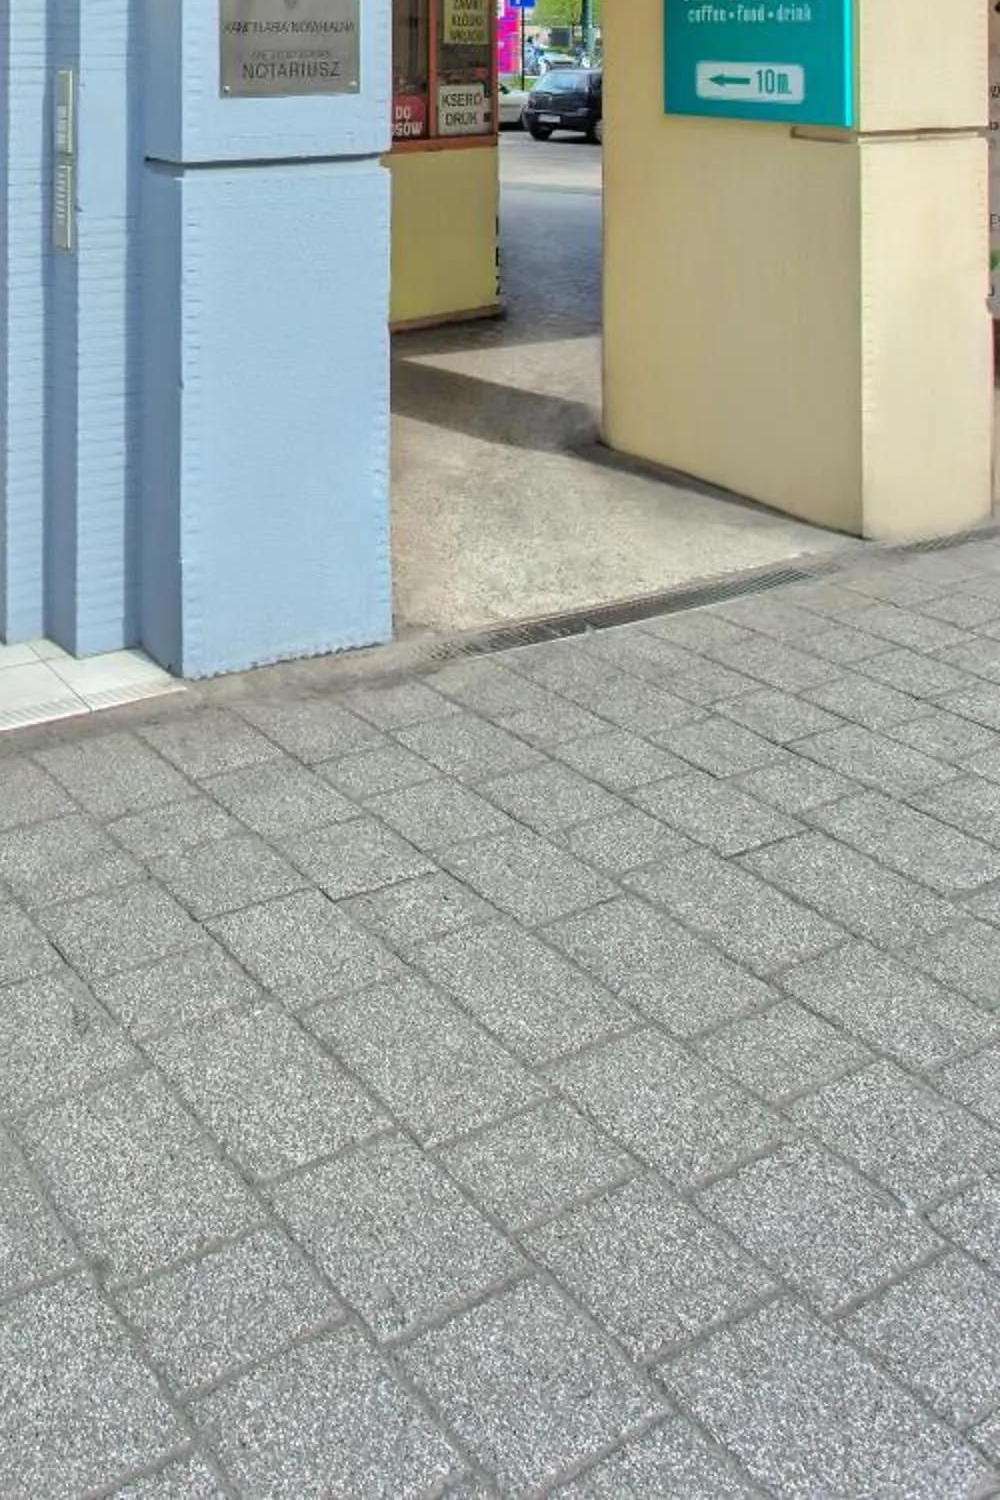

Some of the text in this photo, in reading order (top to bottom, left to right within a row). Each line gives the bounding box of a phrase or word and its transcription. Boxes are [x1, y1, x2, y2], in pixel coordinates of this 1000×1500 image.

[688, 3, 812, 22] coffee food drink
[242, 61, 341, 79] NOTARIUSZ
[442, 92, 482, 107] KSERO
[395, 105, 411, 119] DO
[445, 111, 477, 126] DRUK
